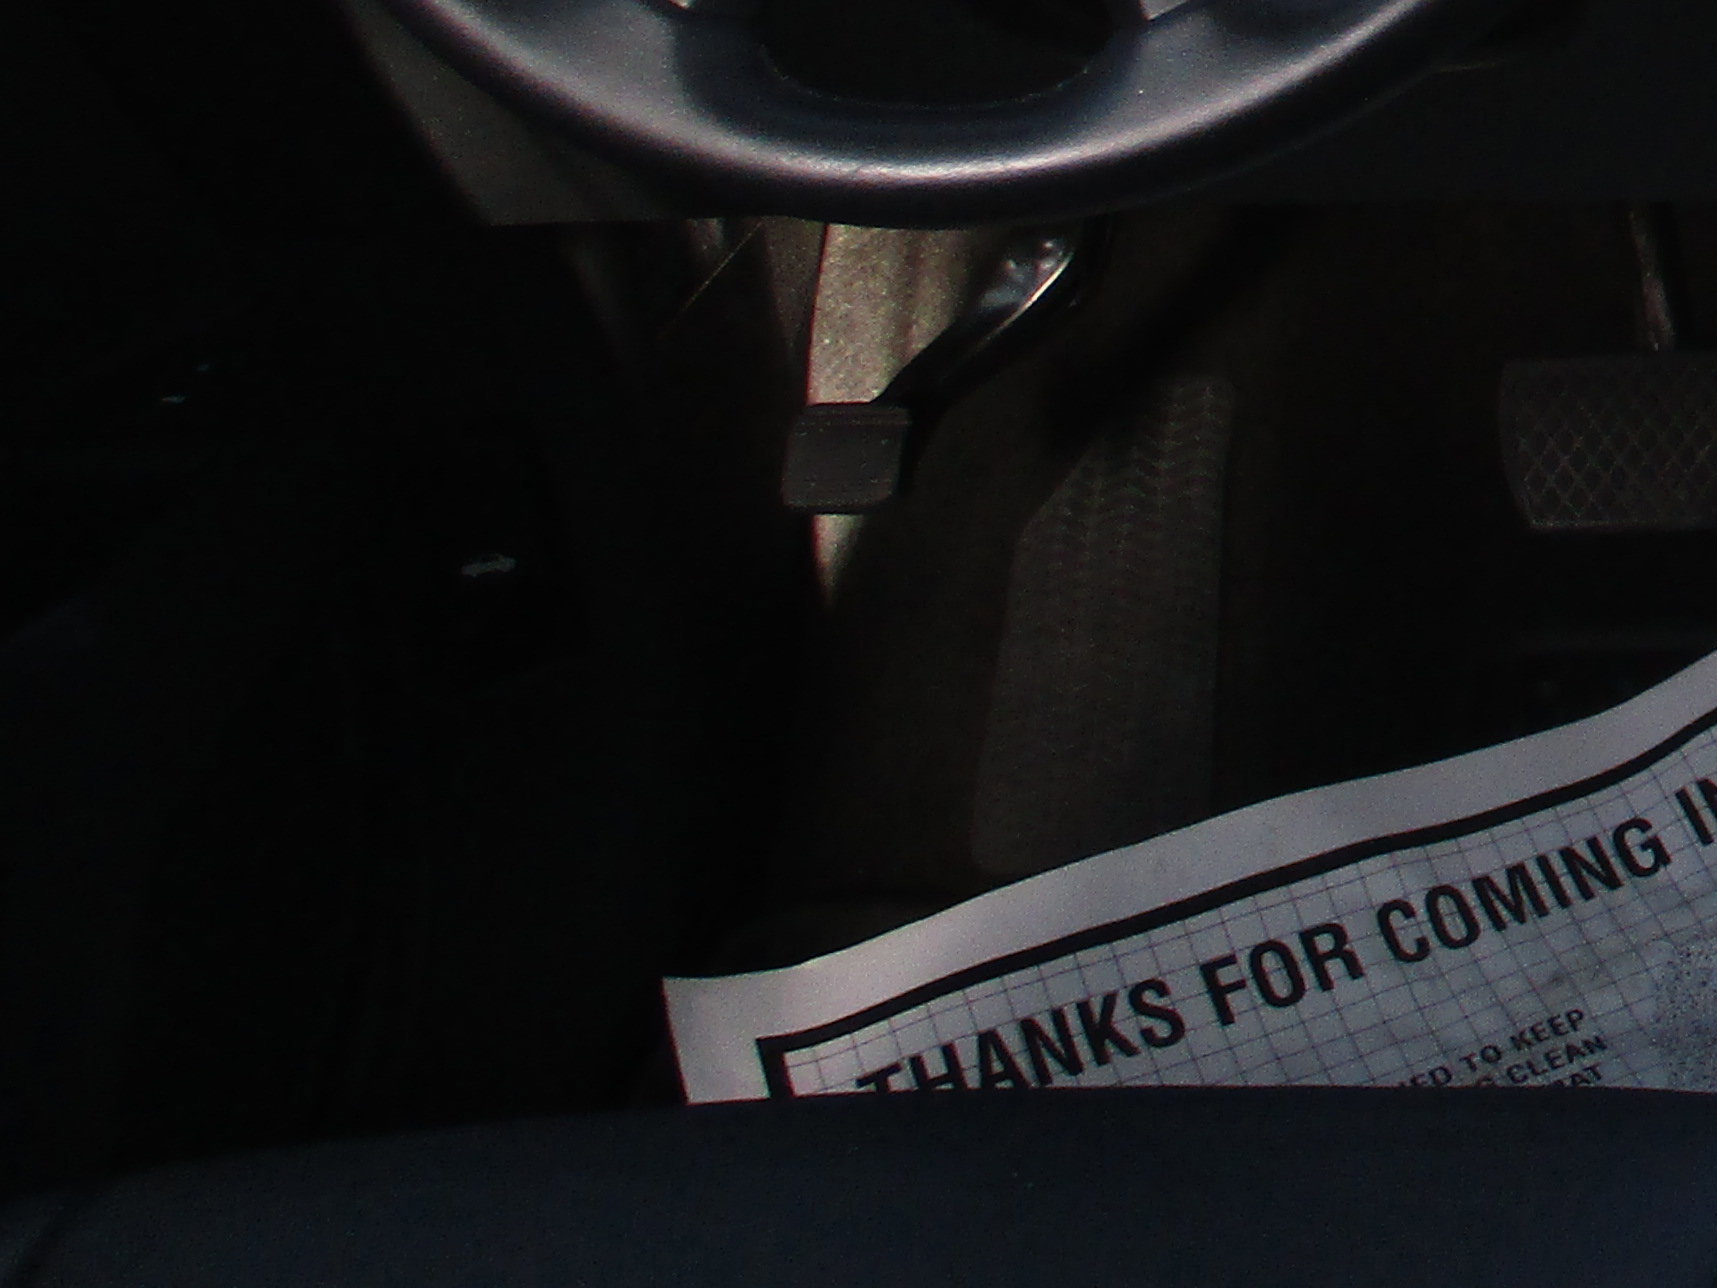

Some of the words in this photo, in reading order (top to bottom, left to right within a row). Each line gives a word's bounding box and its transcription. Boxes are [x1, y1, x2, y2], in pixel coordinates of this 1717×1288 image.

[1201, 922, 1364, 1026] FOR
[1376, 816, 1673, 964] COMING
[1398, 1064, 1452, 1087] ED
[1459, 1044, 1502, 1073] TO
[1509, 1008, 1584, 1051] KEEP
[1506, 1034, 1608, 1084] CLEAN
[1553, 1062, 1604, 1087] AT
